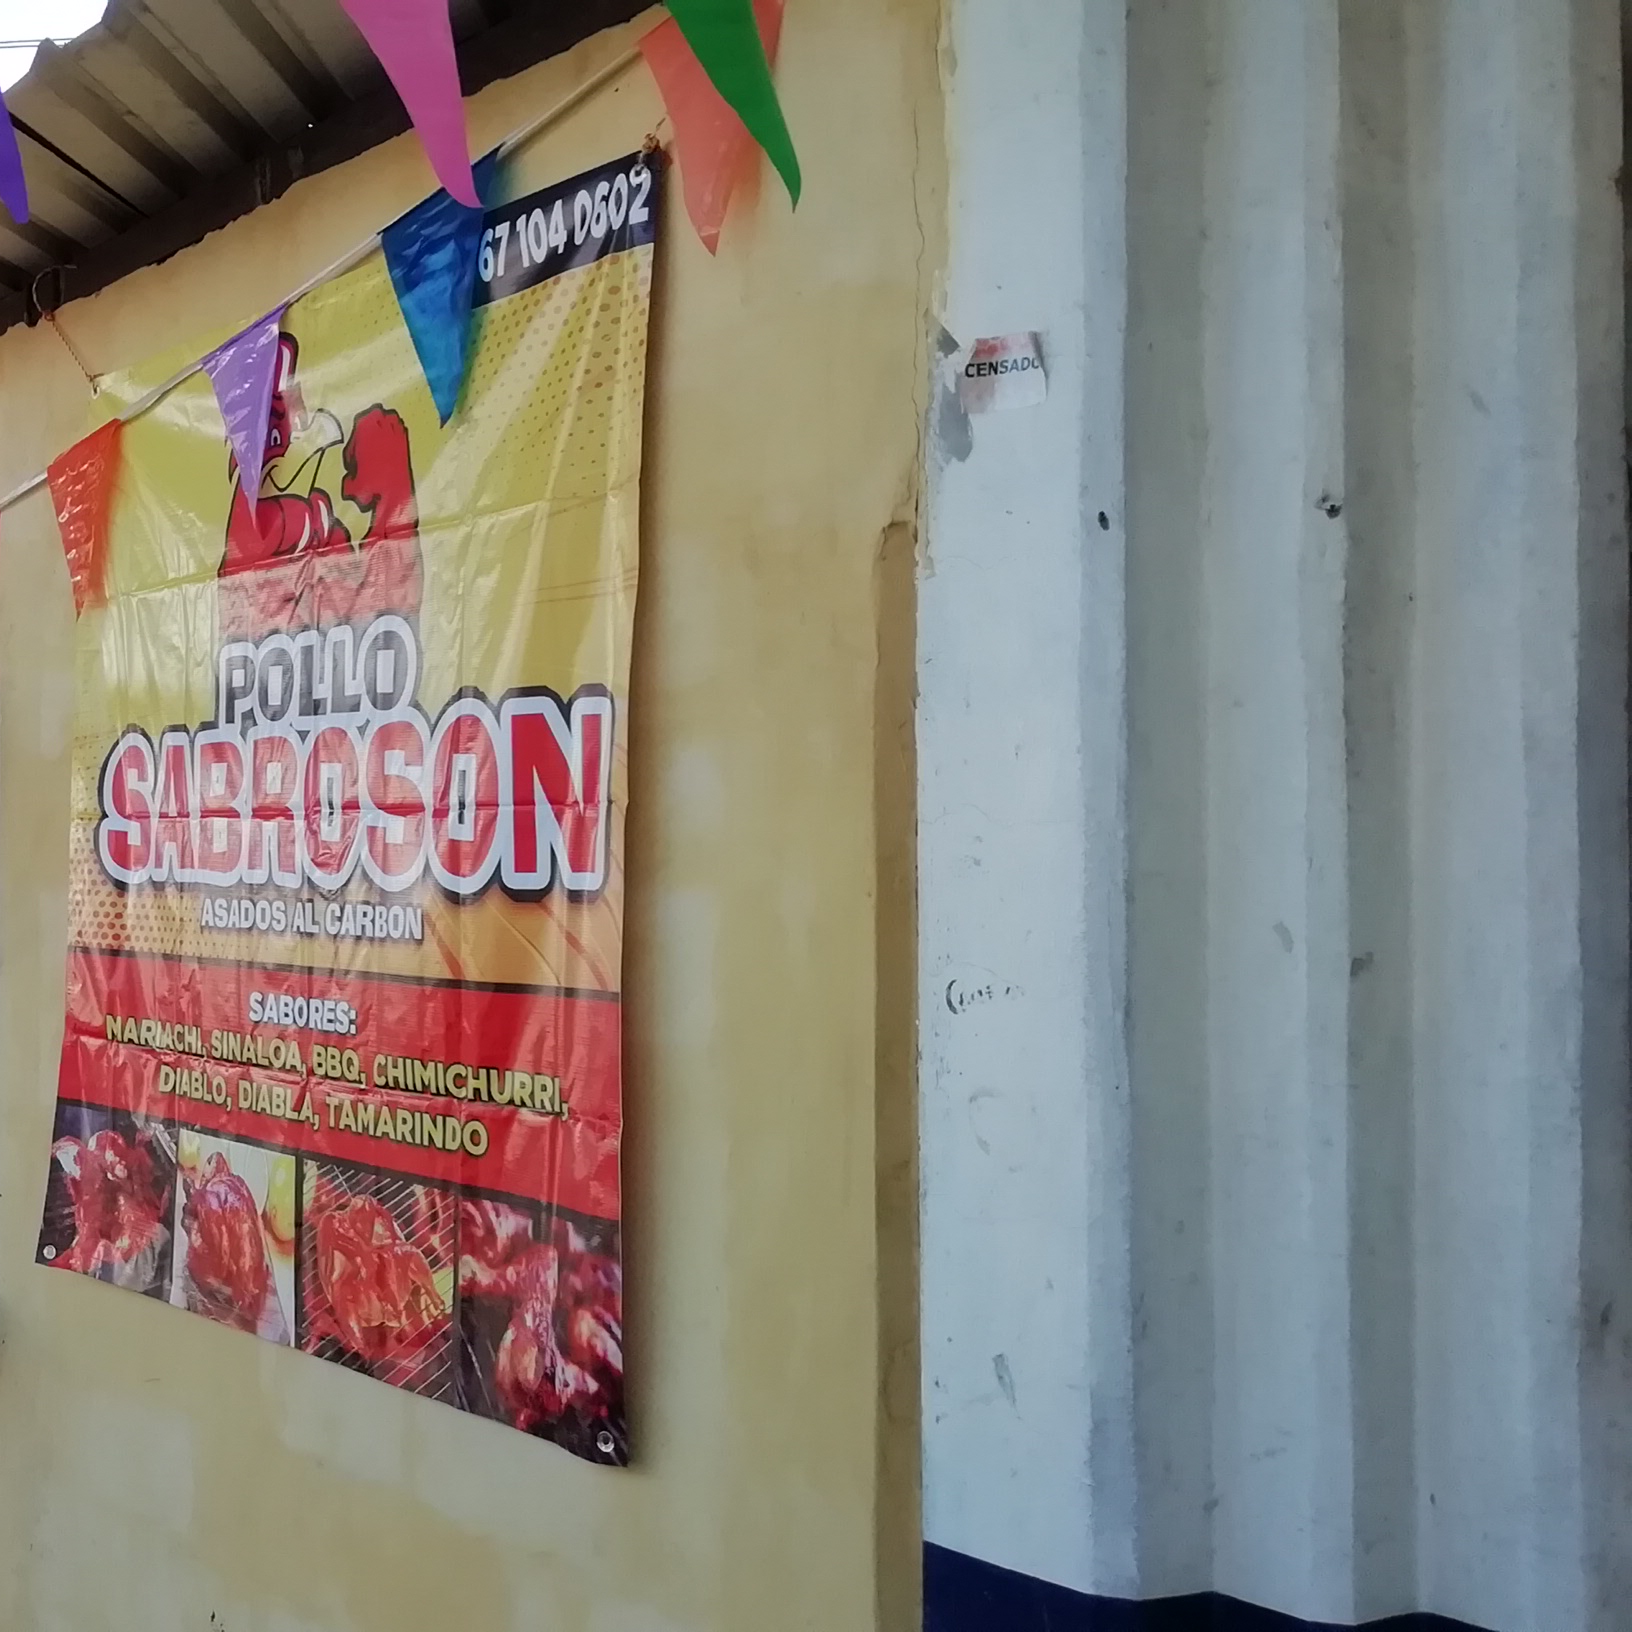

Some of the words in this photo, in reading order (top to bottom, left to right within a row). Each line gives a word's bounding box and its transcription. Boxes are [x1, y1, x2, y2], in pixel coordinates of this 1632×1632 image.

[478, 221, 510, 283] 67
[516, 199, 567, 269] 104
[219, 615, 418, 732] POLLO
[98, 694, 614, 894] SABROSON
[200, 898, 287, 932] ASADOS
[292, 902, 319, 933] AL
[325, 903, 423, 940] CARBON
[249, 991, 358, 1035] SABORES:
[158, 1064, 233, 1112] DIABLO,
[238, 1079, 320, 1131] DIABLA,
[325, 1094, 489, 1157] TAMARINDO
[211, 1028, 307, 1079] SINALOA,
[312, 1043, 367, 1089] BBQ,
[372, 1052, 568, 1121] CHIMICHURRI,
